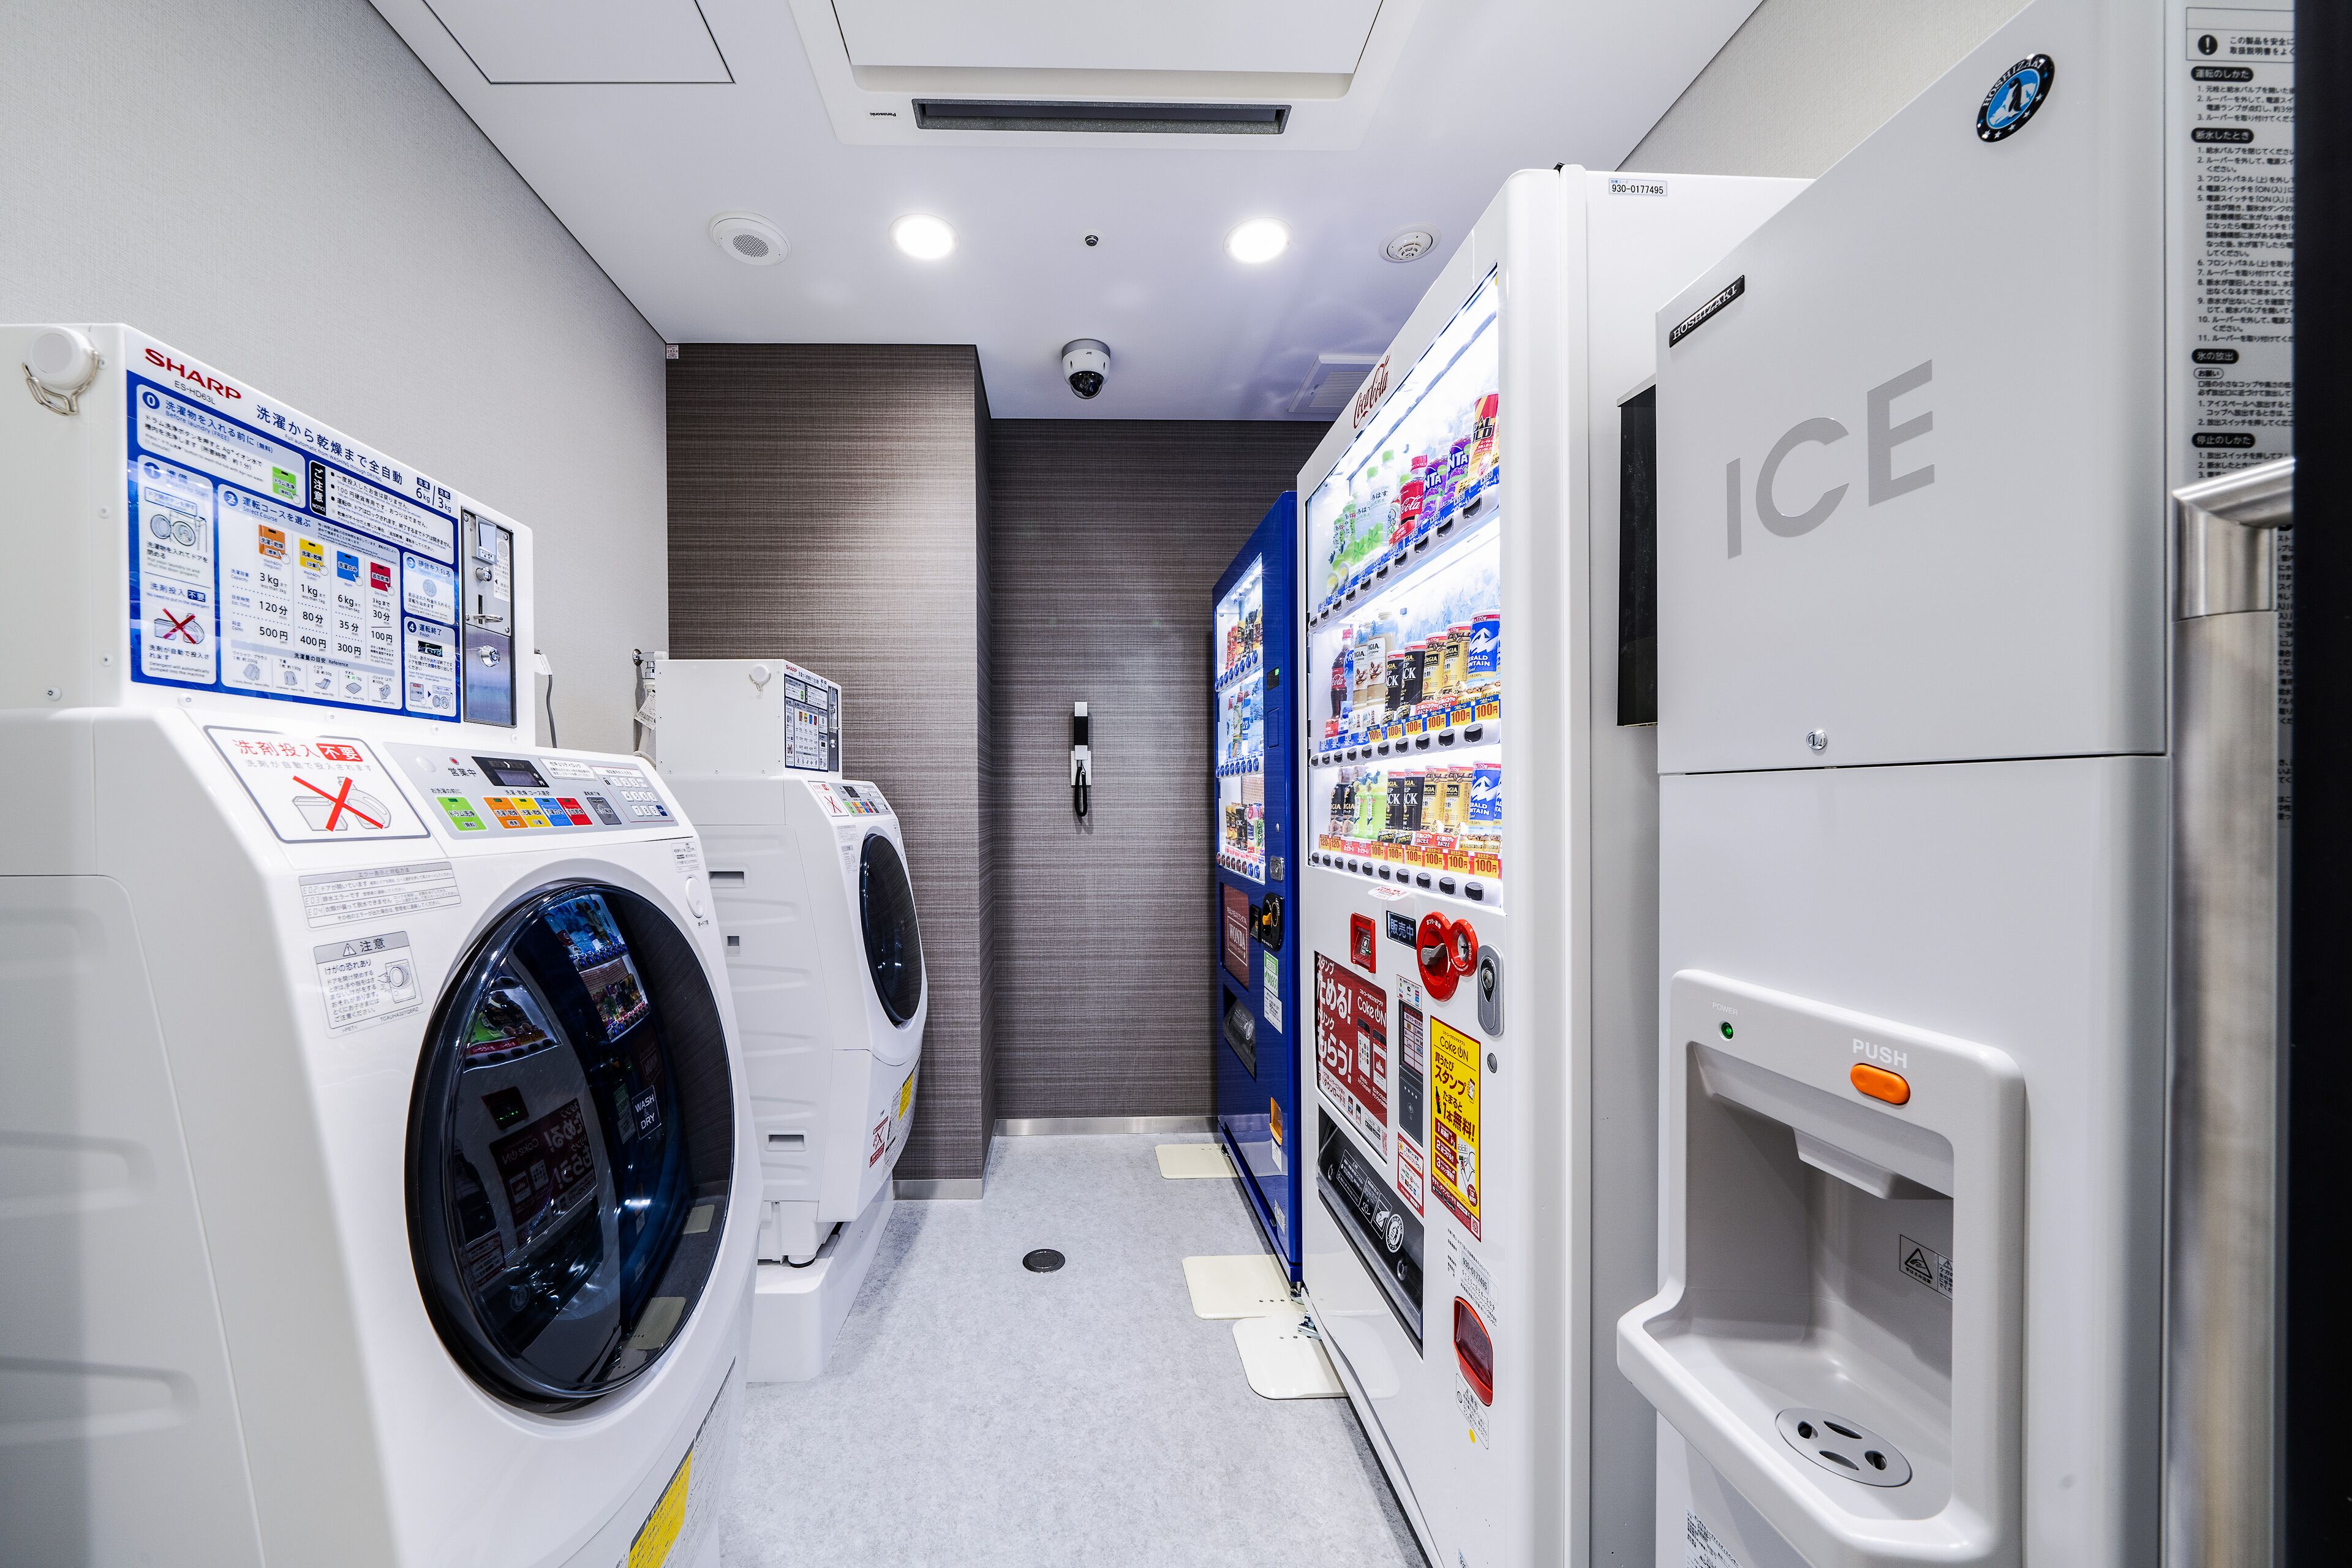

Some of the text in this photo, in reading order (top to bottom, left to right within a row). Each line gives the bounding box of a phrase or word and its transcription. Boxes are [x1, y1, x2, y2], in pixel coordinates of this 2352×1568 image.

[2196, 69, 2248, 78] 運転のしかた
[1983, 58, 2045, 107] HOSHIZAKI
[2196, 130, 2249, 140] 断水したとき
[1612, 184, 1664, 194] 930-0177495
[1673, 284, 1736, 340] HOSHIZAKI
[2198, 352, 2234, 361] 氷の放出
[145, 348, 242, 399] SHARP
[175, 380, 216, 405] ES-HD63L
[1354, 353, 1391, 429] Coca-Cola
[165, 399, 254, 446] 洗濯物を入れる前に
[257, 404, 402, 486] 洗濯から乾燥まで全自動
[2196, 436, 2251, 445] 停止のしかた
[1449, 453, 1469, 471] NTA
[1726, 359, 1936, 560] ICE
[313, 467, 325, 503] ご注意
[242, 496, 311, 527] 運転コースを選ぶ
[312, 503, 326, 513] NOTICE
[260, 512, 277, 522] Course
[338, 562, 358, 573] 洗濯のみ
[260, 573, 265, 583] 3
[372, 573, 390, 583] 追加乾燥
[188, 590, 206, 601] 不要
[259, 601, 288, 616] 120分
[303, 612, 323, 624] 80分
[259, 627, 288, 641] 500円
[371, 631, 393, 643] 100円
[419, 624, 442, 636] 運転終了
[300, 636, 326, 649] 400円
[337, 644, 361, 655] 300円
[294, 653, 349, 668] 洗濯量の目安 Reference
[785, 664, 797, 673] SHARP
[1452, 709, 1470, 723] 100円
[1476, 704, 1498, 718] 100円
[1406, 721, 1422, 733] 100円
[1428, 715, 1445, 728] 100円
[1387, 725, 1402, 739] 100円
[232, 739, 361, 761] 洗剤投入 不要
[448, 767, 477, 777] 営業中
[1371, 847, 1384, 856] 100円
[1389, 848, 1401, 859] 100円
[1406, 850, 1421, 862] 100円
[1426, 853, 1442, 865] 100円
[1449, 856, 1468, 869] 100円
[1476, 859, 1496, 873] 100円
[1390, 918, 1414, 940] 販売中
[1229, 923, 1245, 950] WONDA
[360, 938, 385, 952] 注意
[325, 959, 371, 974] けがの恐れあり
[1357, 996, 1387, 1028] Coke ON
[1712, 1001, 1738, 1016] POWER
[1440, 1036, 1469, 1062] Coke ON
[1852, 1039, 1908, 1068] PUSH
[1435, 1052, 1454, 1072] 買うたび
[1435, 1065, 1466, 1096] スタンプ
[635, 1094, 654, 1112] WASH
[1443, 1090, 1463, 1113] たまると
[641, 1112, 655, 1129] DRY
[1463, 1257, 1487, 1290] 930-0177495
